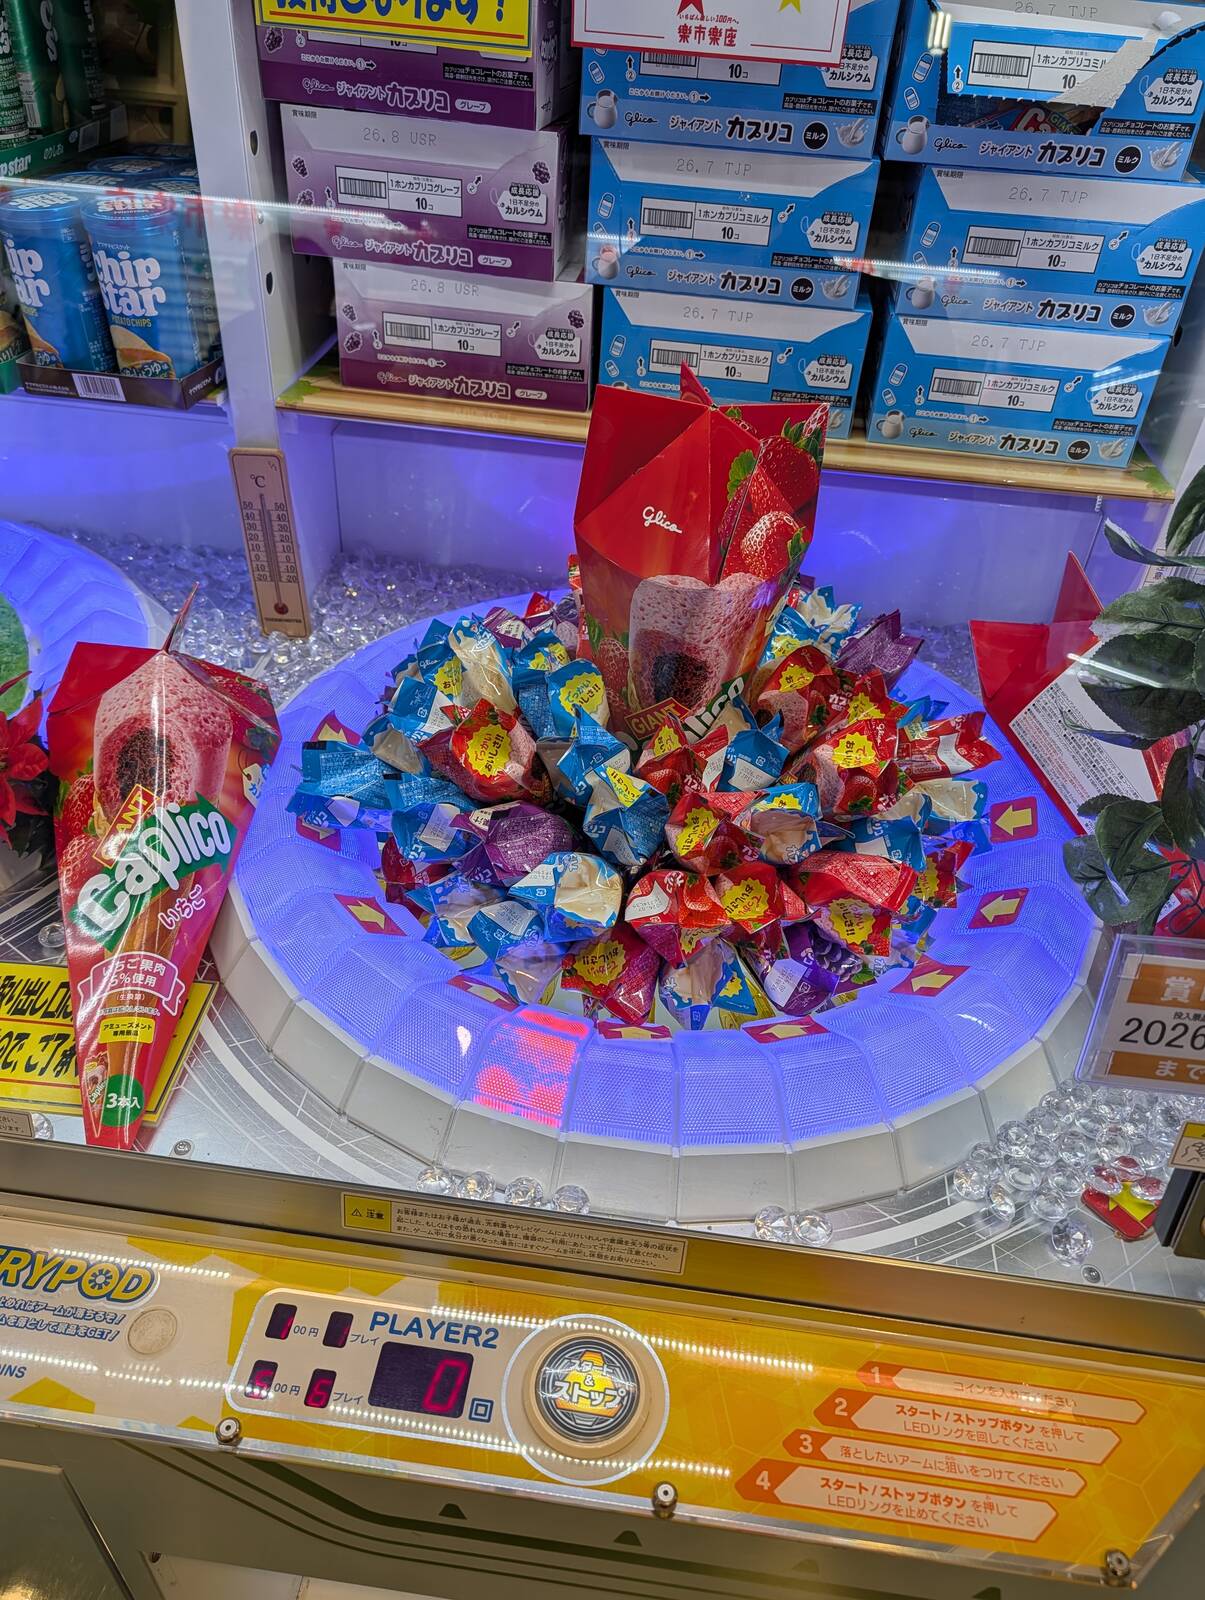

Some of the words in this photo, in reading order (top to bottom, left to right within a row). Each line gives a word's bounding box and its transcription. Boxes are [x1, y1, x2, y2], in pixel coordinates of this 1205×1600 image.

[1069, 5, 1097, 19] TJP
[729, 63, 748, 79] 10コ
[828, 71, 870, 83] カルシウム
[336, 82, 386, 100] ジャイアント
[459, 102, 487, 111] グレープ
[1151, 94, 1192, 107] カルシウム
[292, 110, 317, 119] 賞味期限
[669, 116, 722, 134] ジャイアント
[805, 130, 826, 141] ミルク
[410, 132, 436, 146] USR
[604, 141, 629, 150] 賞味期限
[979, 143, 1033, 158] ジャイアント
[1117, 155, 1138, 164] ミルク
[725, 161, 752, 177] TJP
[936, 169, 964, 179] 賞味期限
[1060, 190, 1088, 203] TJP
[416, 197, 434, 211] 10コ
[504, 206, 542, 218] カルシウム
[721, 226, 740, 241] 10コ
[814, 233, 853, 245] カルシウム
[365, 239, 413, 255] ジャイアント
[482, 258, 508, 266] グレープ
[343, 262, 367, 271] 賞味期限
[1047, 254, 1066, 268] 10コ
[1142, 260, 1183, 272] カルシウム
[455, 282, 480, 296] USR
[668, 270, 715, 285] ジャイアント
[793, 285, 812, 294] ミルク
[615, 290, 640, 298] 賞味期限
[728, 310, 754, 322] TJP
[983, 299, 1034, 313] ジャイアント
[1112, 311, 1132, 320] ミルク
[903, 317, 928, 326] 賞味期限
[457, 340, 475, 351] 10コ
[1019, 338, 1047, 351] TJP
[541, 348, 577, 358] カルシウム
[725, 366, 742, 378] 10コ
[810, 373, 846, 384] カルシウム
[408, 375, 454, 391] ジャイアント
[519, 391, 544, 399] グレープ
[1007, 394, 1024, 408] 10コ
[1096, 402, 1134, 413] カルシウム
[949, 431, 995, 446] ジャイアント
[1069, 446, 1089, 455] ミルク
[642, 506, 682, 534] Glico
[78, 802, 231, 931] Caplico
[158, 884, 205, 930] いちご
[1160, 975, 1205, 1003] 賞
[106, 1093, 141, 1109] 3本入
[366, 1211, 385, 1220] 注意
[370, 1311, 499, 1349] PLAYER2
[350, 1333, 380, 1346] プレイ
[569, 1360, 614, 1375] スタート
[584, 1375, 594, 1386] &
[871, 1367, 881, 1384] 1
[421, 1358, 469, 1413] 0
[333, 1392, 363, 1403] プレイ
[554, 1381, 627, 1408] ストップ
[834, 1398, 848, 1416] 2
[904, 1420, 1058, 1452] LEDリングを回してください
[799, 1434, 813, 1454] 3
[840, 1445, 1064, 1489] 落としたいアームに狙いをつけてください
[755, 1471, 771, 1490] 4
[828, 1494, 989, 1529] LEDリングを止めてください
